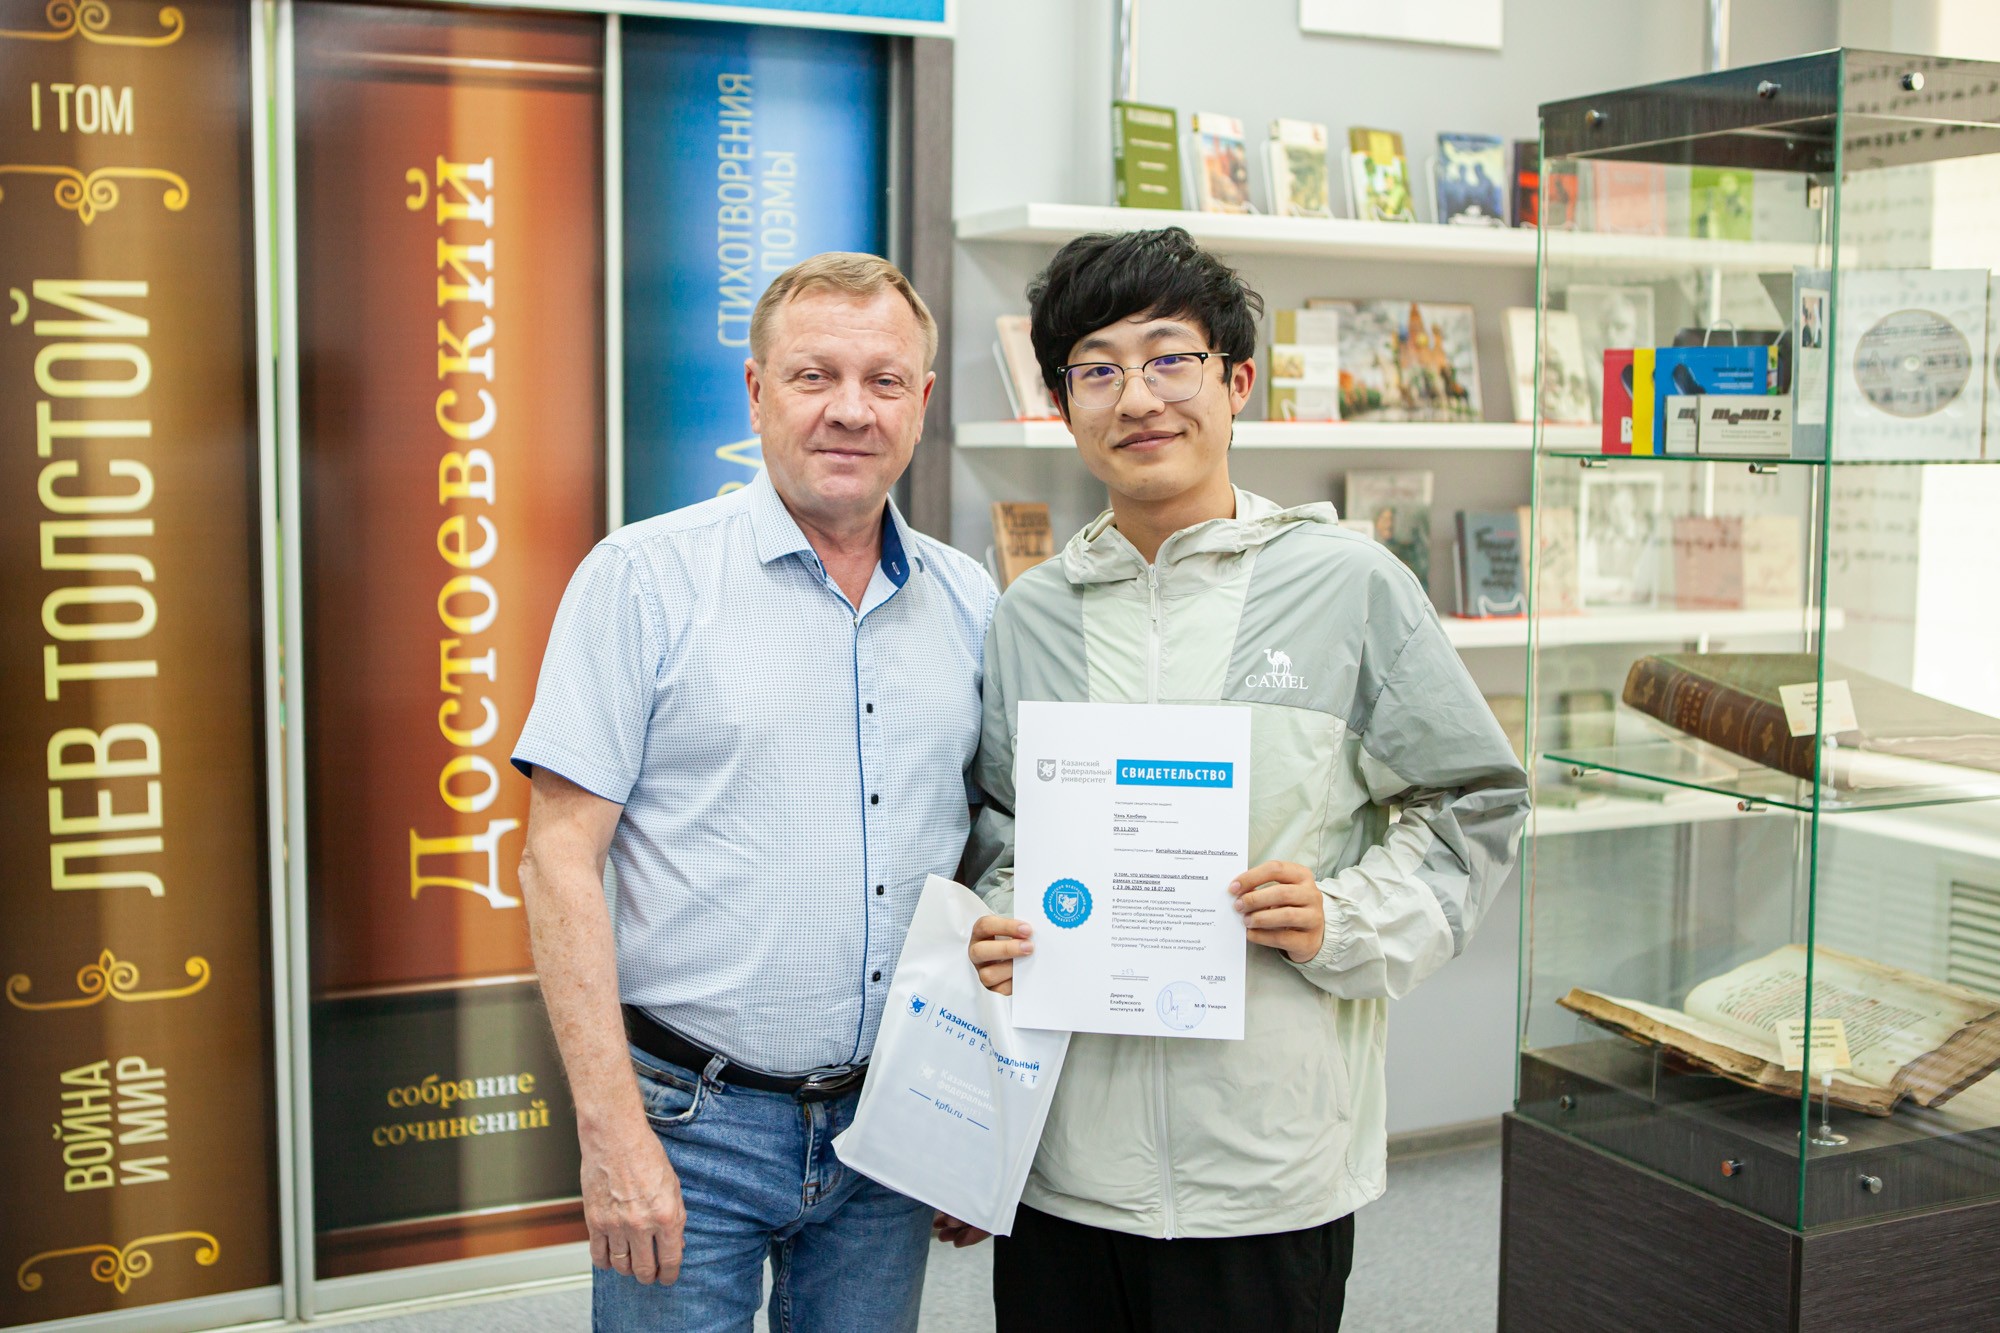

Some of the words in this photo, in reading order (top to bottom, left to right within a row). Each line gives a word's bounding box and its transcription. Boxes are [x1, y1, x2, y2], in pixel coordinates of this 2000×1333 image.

[50, 83, 134, 135] ТОМ
[717, 73, 753, 347] СТИХОТВОРЕНИЯ
[760, 151, 796, 272] ПОЭМЫ
[10, 280, 158, 701] ТОЛСТОЙ
[405, 156, 521, 909] Достоевский
[1245, 675, 1309, 690] CAMEL
[1060, 767, 1112, 776] федеральный
[1060, 776, 1107, 784] университет
[1061, 760, 1100, 768] Казанский
[1121, 766, 1226, 781] СВИДЕТЕЛЬСТВО
[47, 723, 165, 897] ЛЕВ
[939, 1008, 988, 1040] Казанский
[116, 1056, 169, 1145] МИР
[387, 1072, 536, 1110] собрание
[935, 1099, 963, 1118] kpfu.ru
[52, 1060, 115, 1193] ВОЙНА
[372, 1099, 550, 1147] сочинений
[119, 1156, 170, 1186] И
